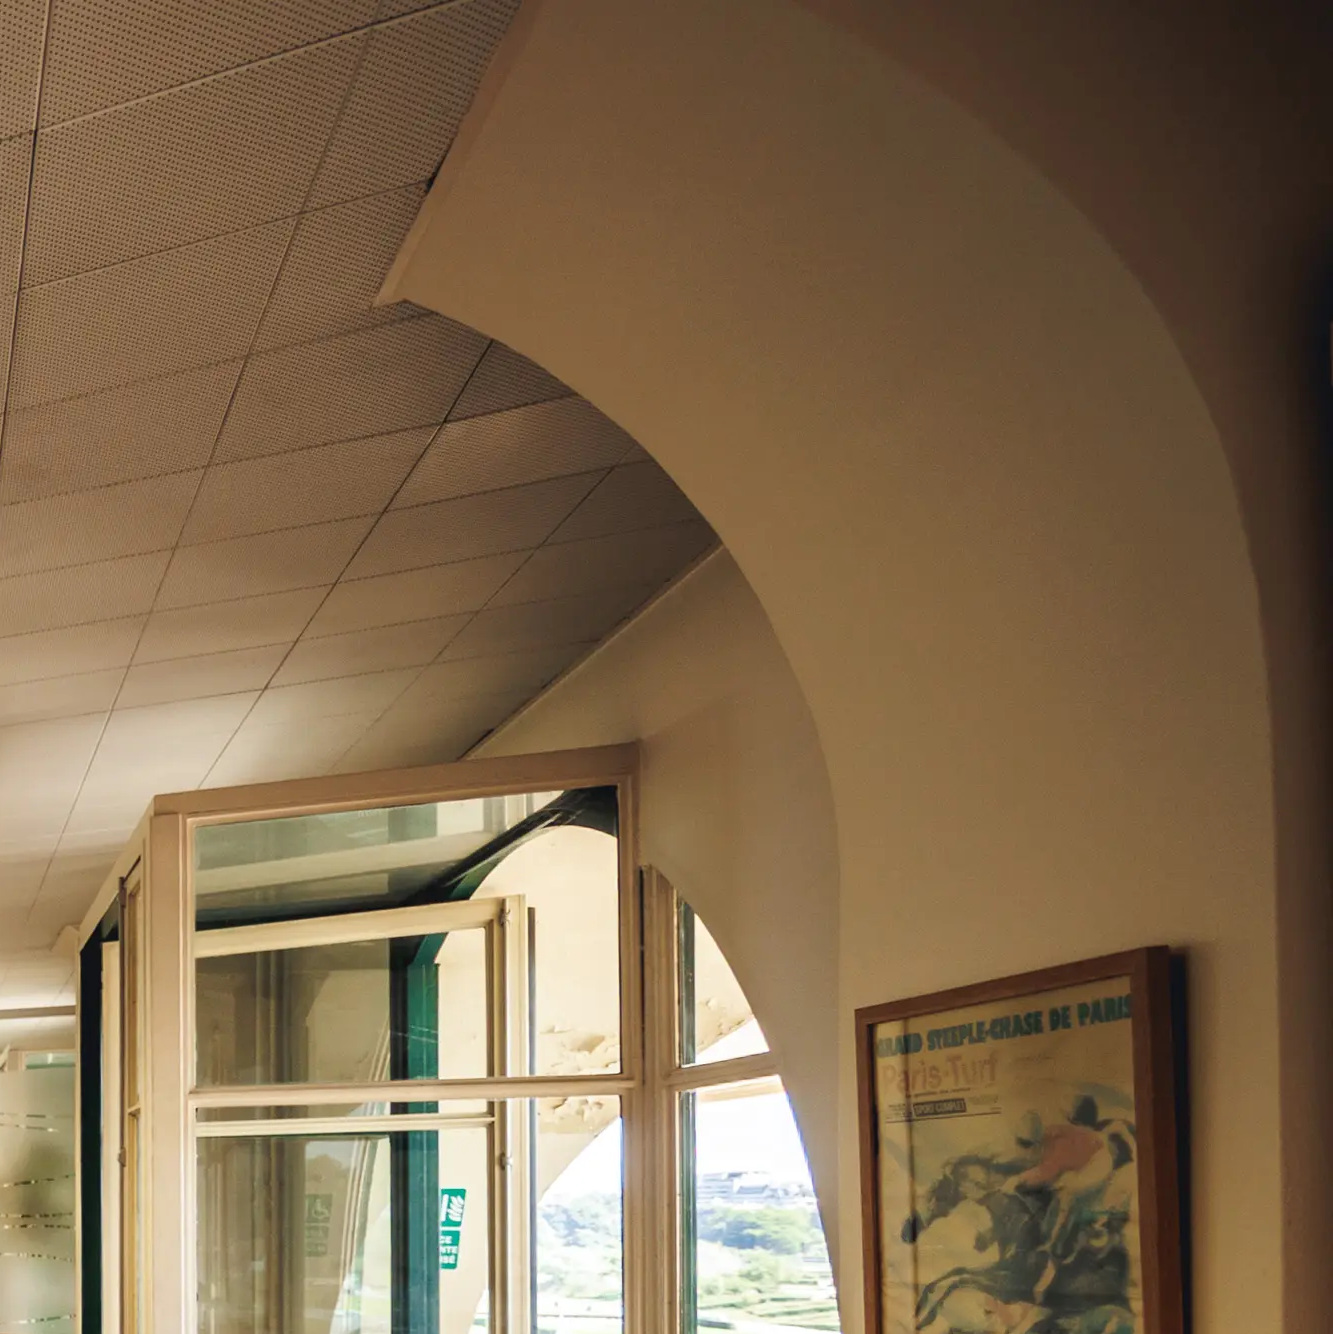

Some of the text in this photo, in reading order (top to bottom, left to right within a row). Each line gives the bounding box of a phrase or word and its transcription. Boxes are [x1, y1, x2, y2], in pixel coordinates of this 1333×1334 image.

[1048, 1004, 1071, 1031] DE
[1077, 993, 1132, 1027] PARIS
[881, 1050, 1000, 1096] Paris-Turf
